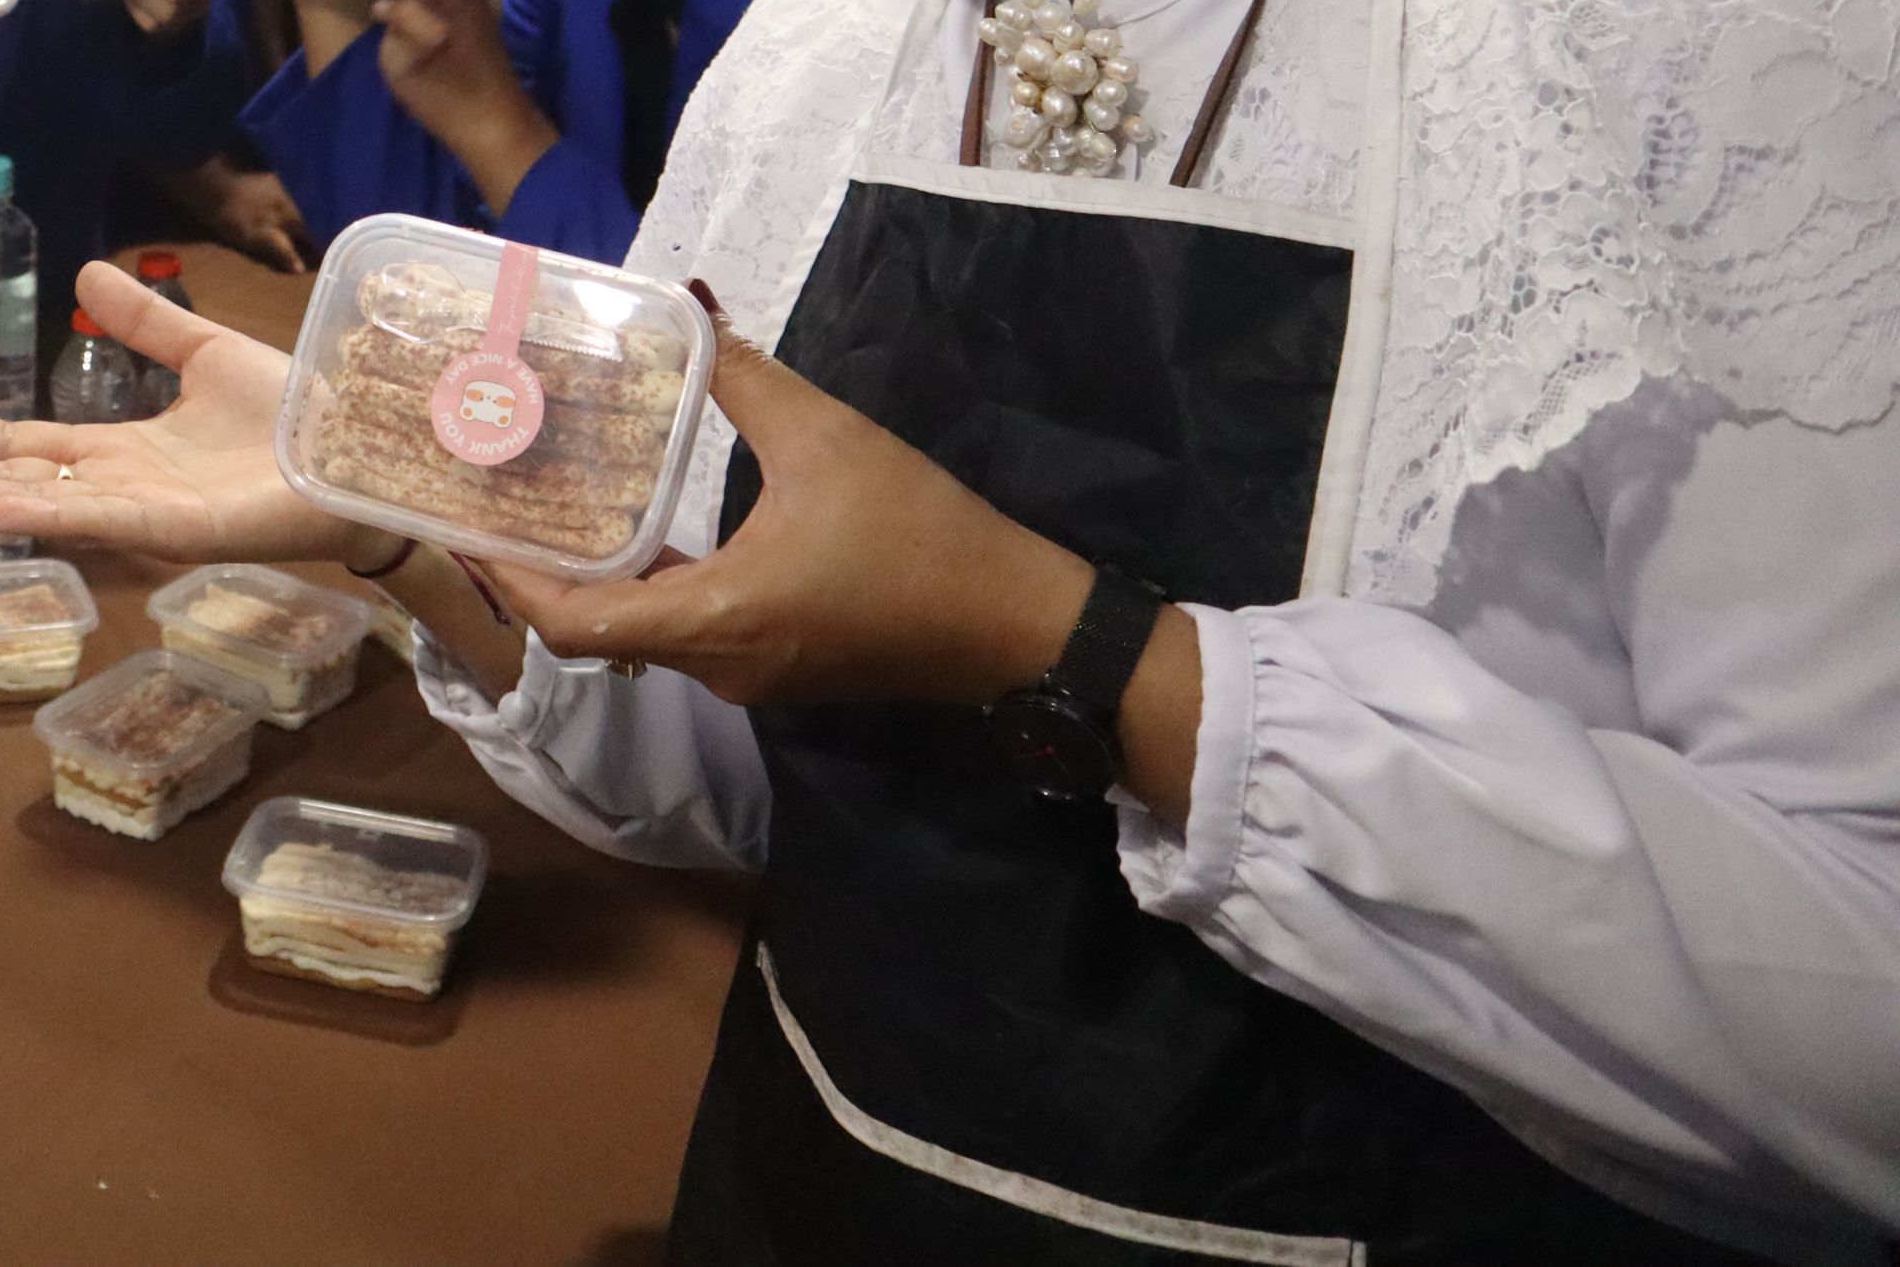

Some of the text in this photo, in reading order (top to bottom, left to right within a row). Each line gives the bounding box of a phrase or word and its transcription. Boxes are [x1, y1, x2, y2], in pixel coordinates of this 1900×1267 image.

[446, 353, 539, 405] HAVE A NICE DAY
[441, 412, 528, 455] THANK YOU
